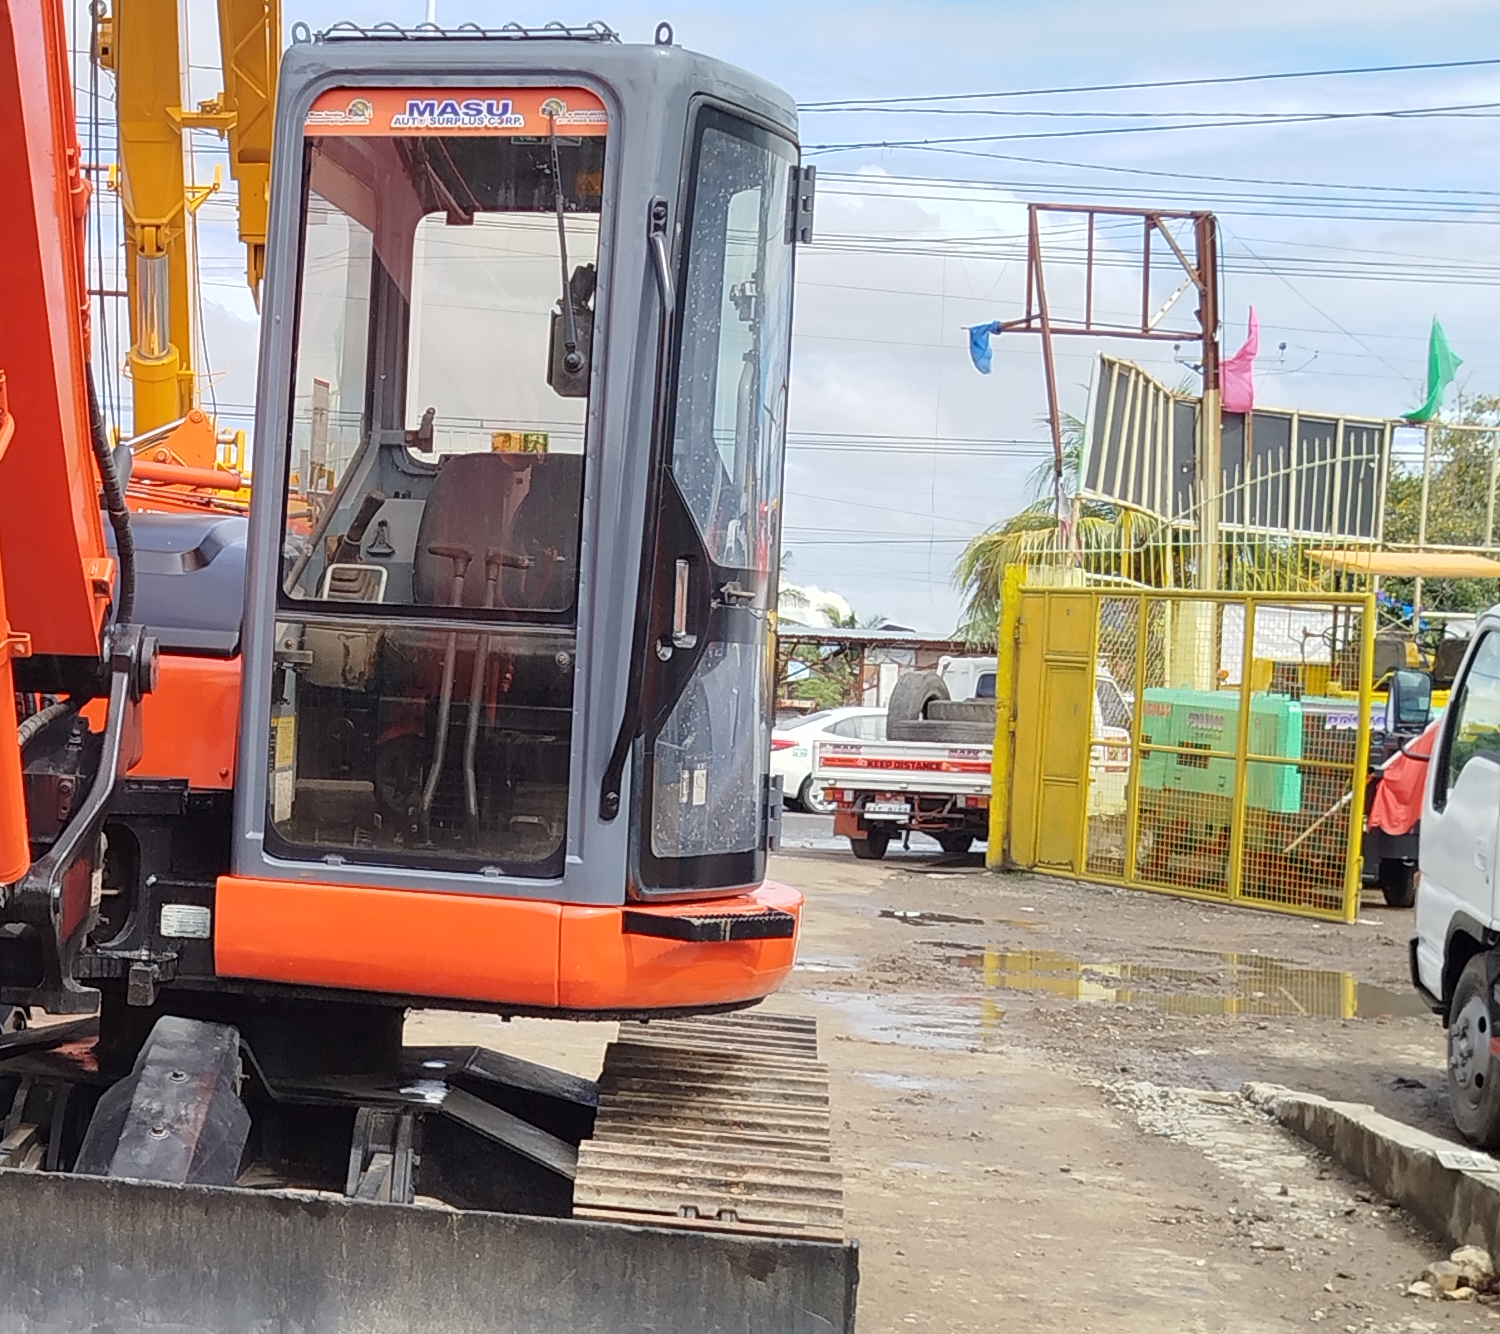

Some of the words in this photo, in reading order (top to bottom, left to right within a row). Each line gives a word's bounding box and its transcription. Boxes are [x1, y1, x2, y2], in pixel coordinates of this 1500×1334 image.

[407, 102, 510, 117] MASU
[393, 116, 426, 126] AUTO
[429, 116, 485, 126] SURPLUS
[866, 758, 892, 769] KEEP
[893, 759, 941, 771] DISTANCE
